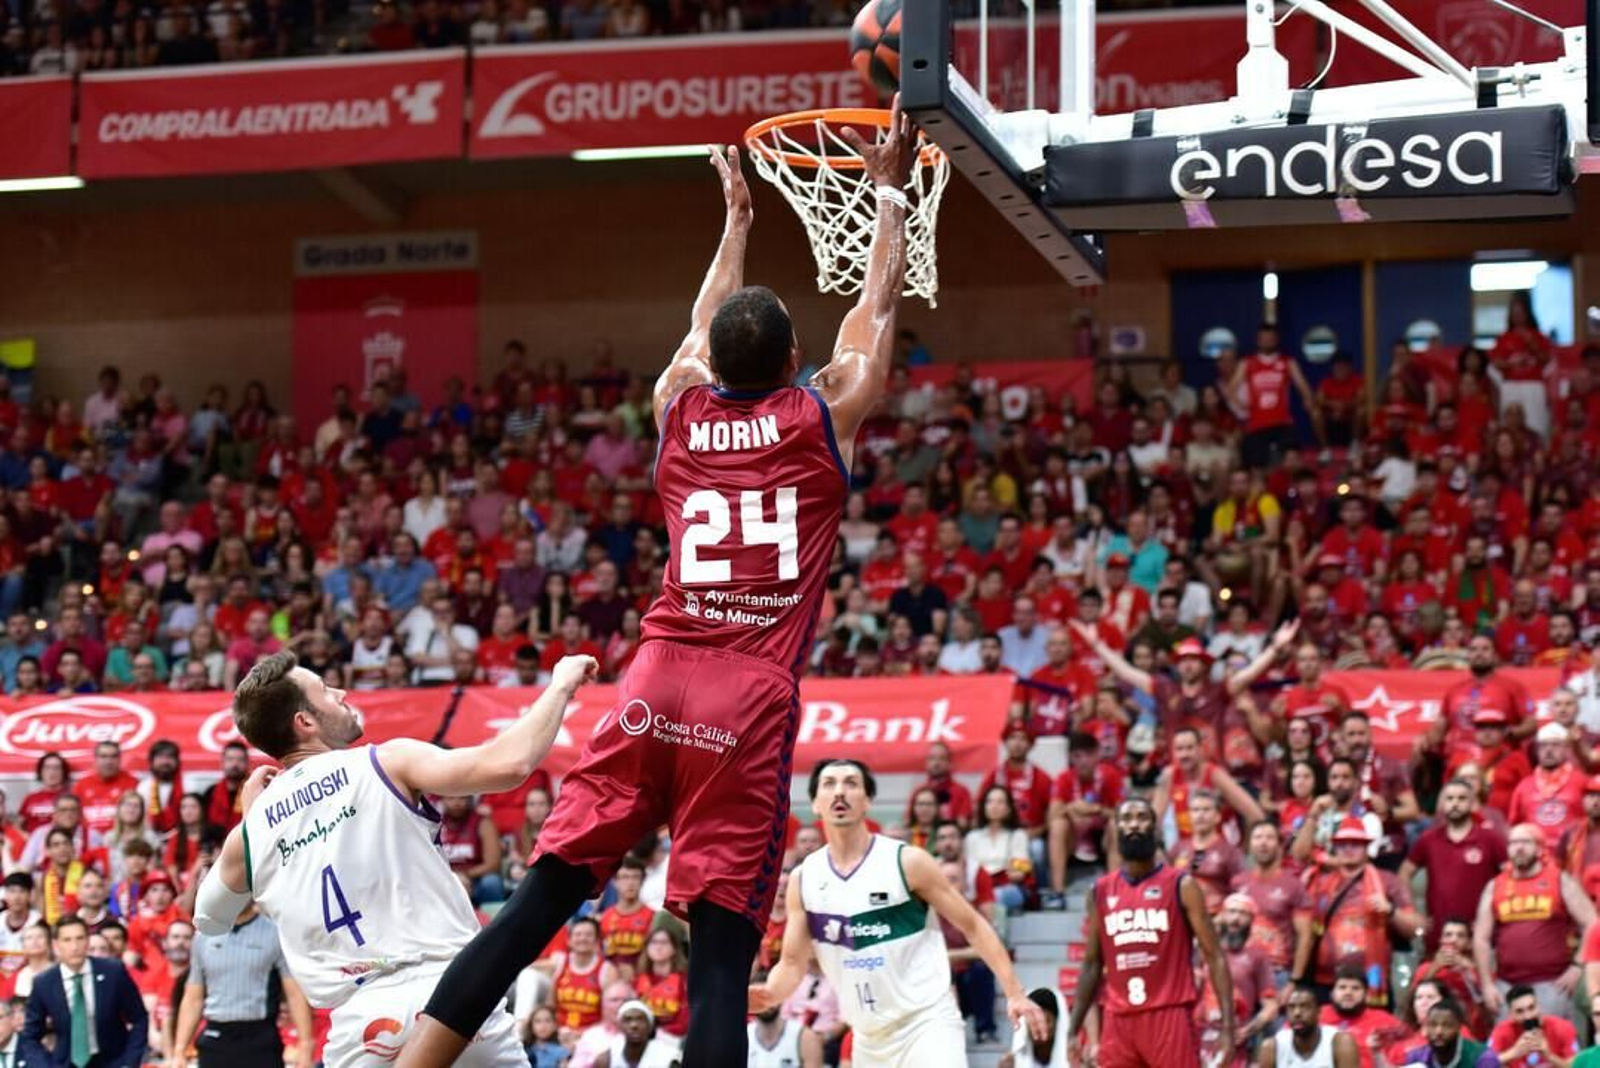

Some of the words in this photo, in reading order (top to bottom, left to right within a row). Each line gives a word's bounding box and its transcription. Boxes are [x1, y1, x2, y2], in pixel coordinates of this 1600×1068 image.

[545, 71, 866, 123] GRUPOSURESTE
[99, 99, 389, 143] COMPRALAENTRADA
[1170, 125, 1503, 200] endesa
[304, 244, 386, 267] Grada
[397, 239, 469, 262] Norte
[688, 414, 780, 452] MORIN
[679, 486, 799, 583] 24
[704, 607, 724, 620] de
[13, 718, 136, 744] Juver
[653, 714, 690, 736] Costa
[693, 723, 738, 748] Cálida
[796, 697, 967, 743] Bank
[652, 728, 681, 744] Región
[682, 735, 693, 746] de
[693, 738, 724, 754] Murcia
[264, 767, 350, 829] KALINOSKI
[322, 864, 366, 947] 4
[1104, 907, 1169, 936] UCAM
[855, 982, 877, 1012] 14
[1127, 976, 1147, 1005] 8
